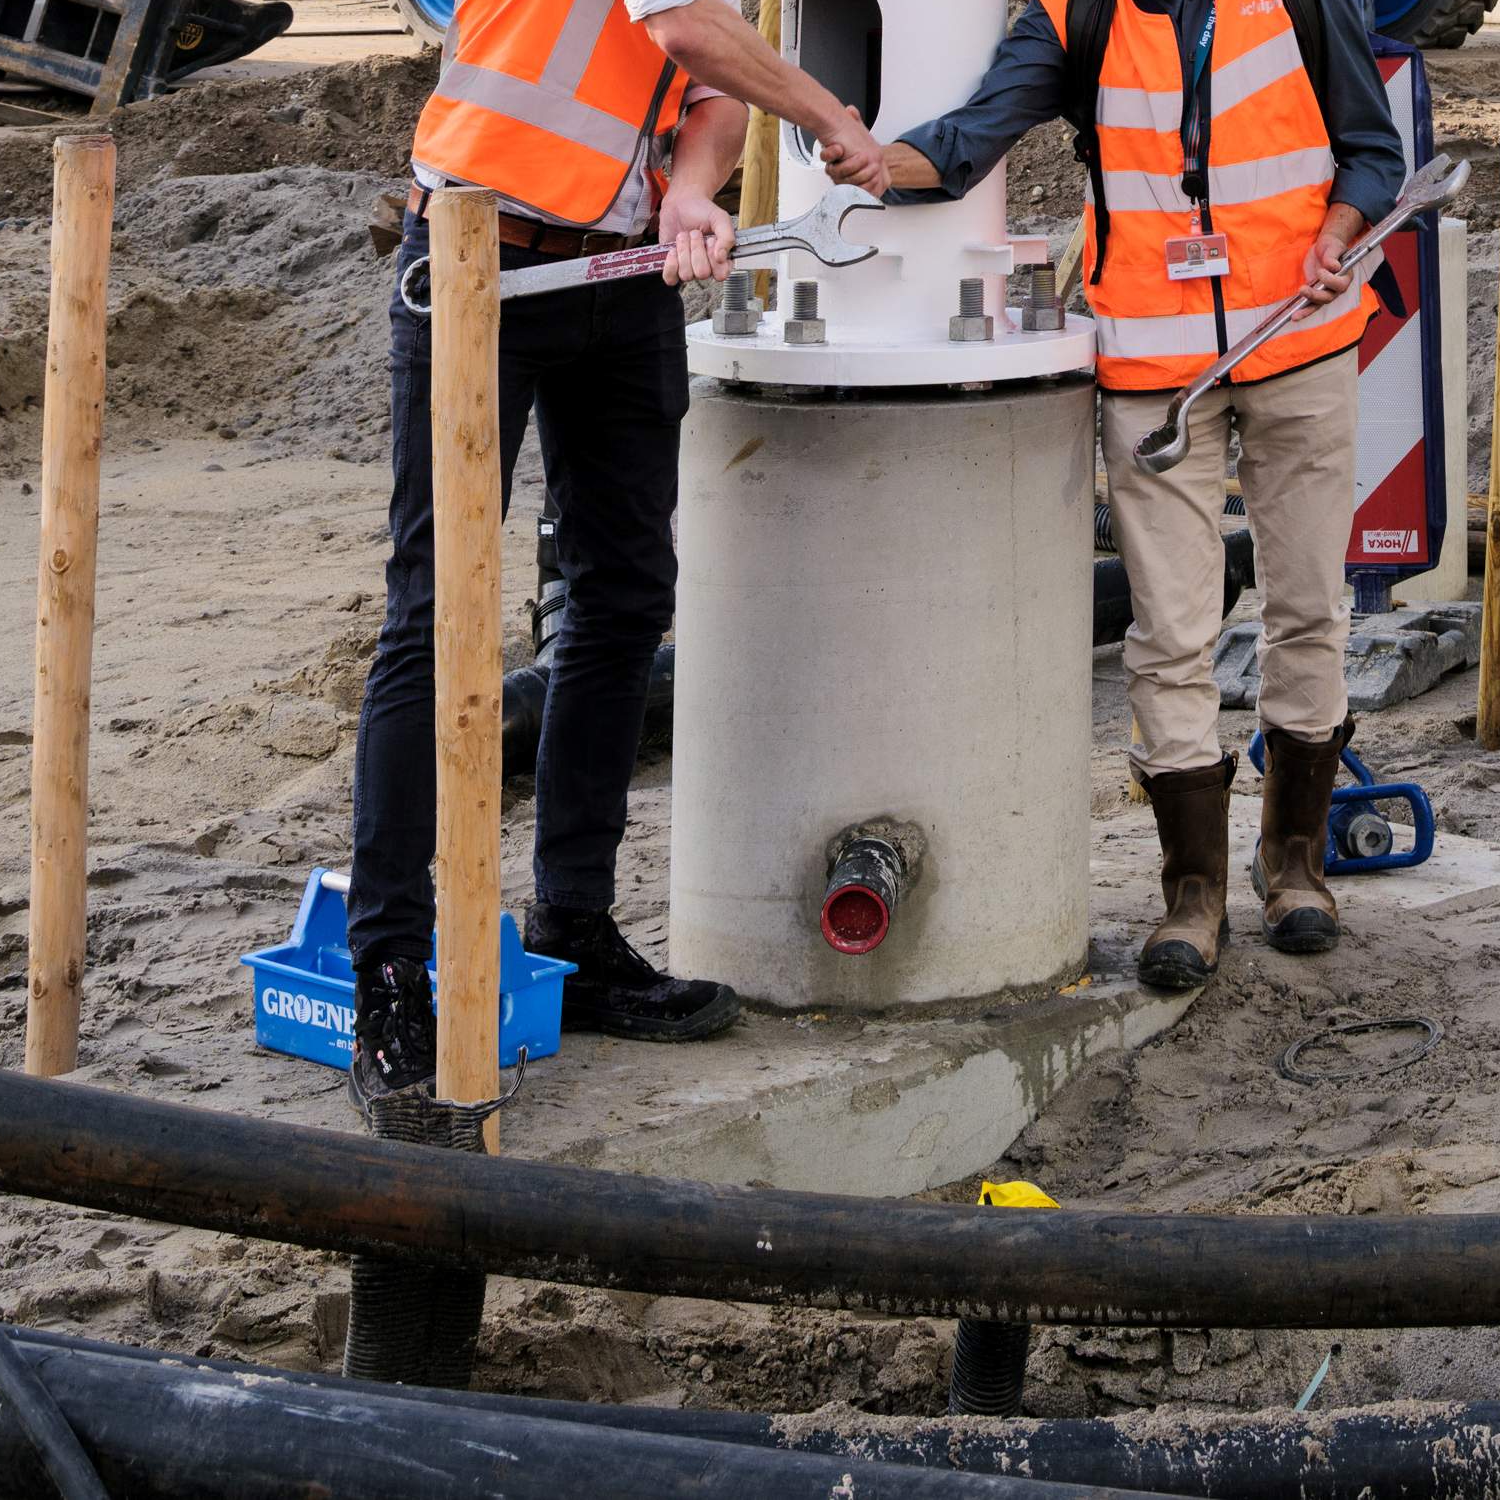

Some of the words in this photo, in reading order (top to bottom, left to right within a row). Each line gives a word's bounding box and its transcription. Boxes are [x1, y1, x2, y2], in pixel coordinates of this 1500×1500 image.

[1206, 15, 1216, 30] the
[1199, 31, 1211, 47] day
[1368, 539, 1401, 549] HOKA
[336, 1039, 348, 1049] en
